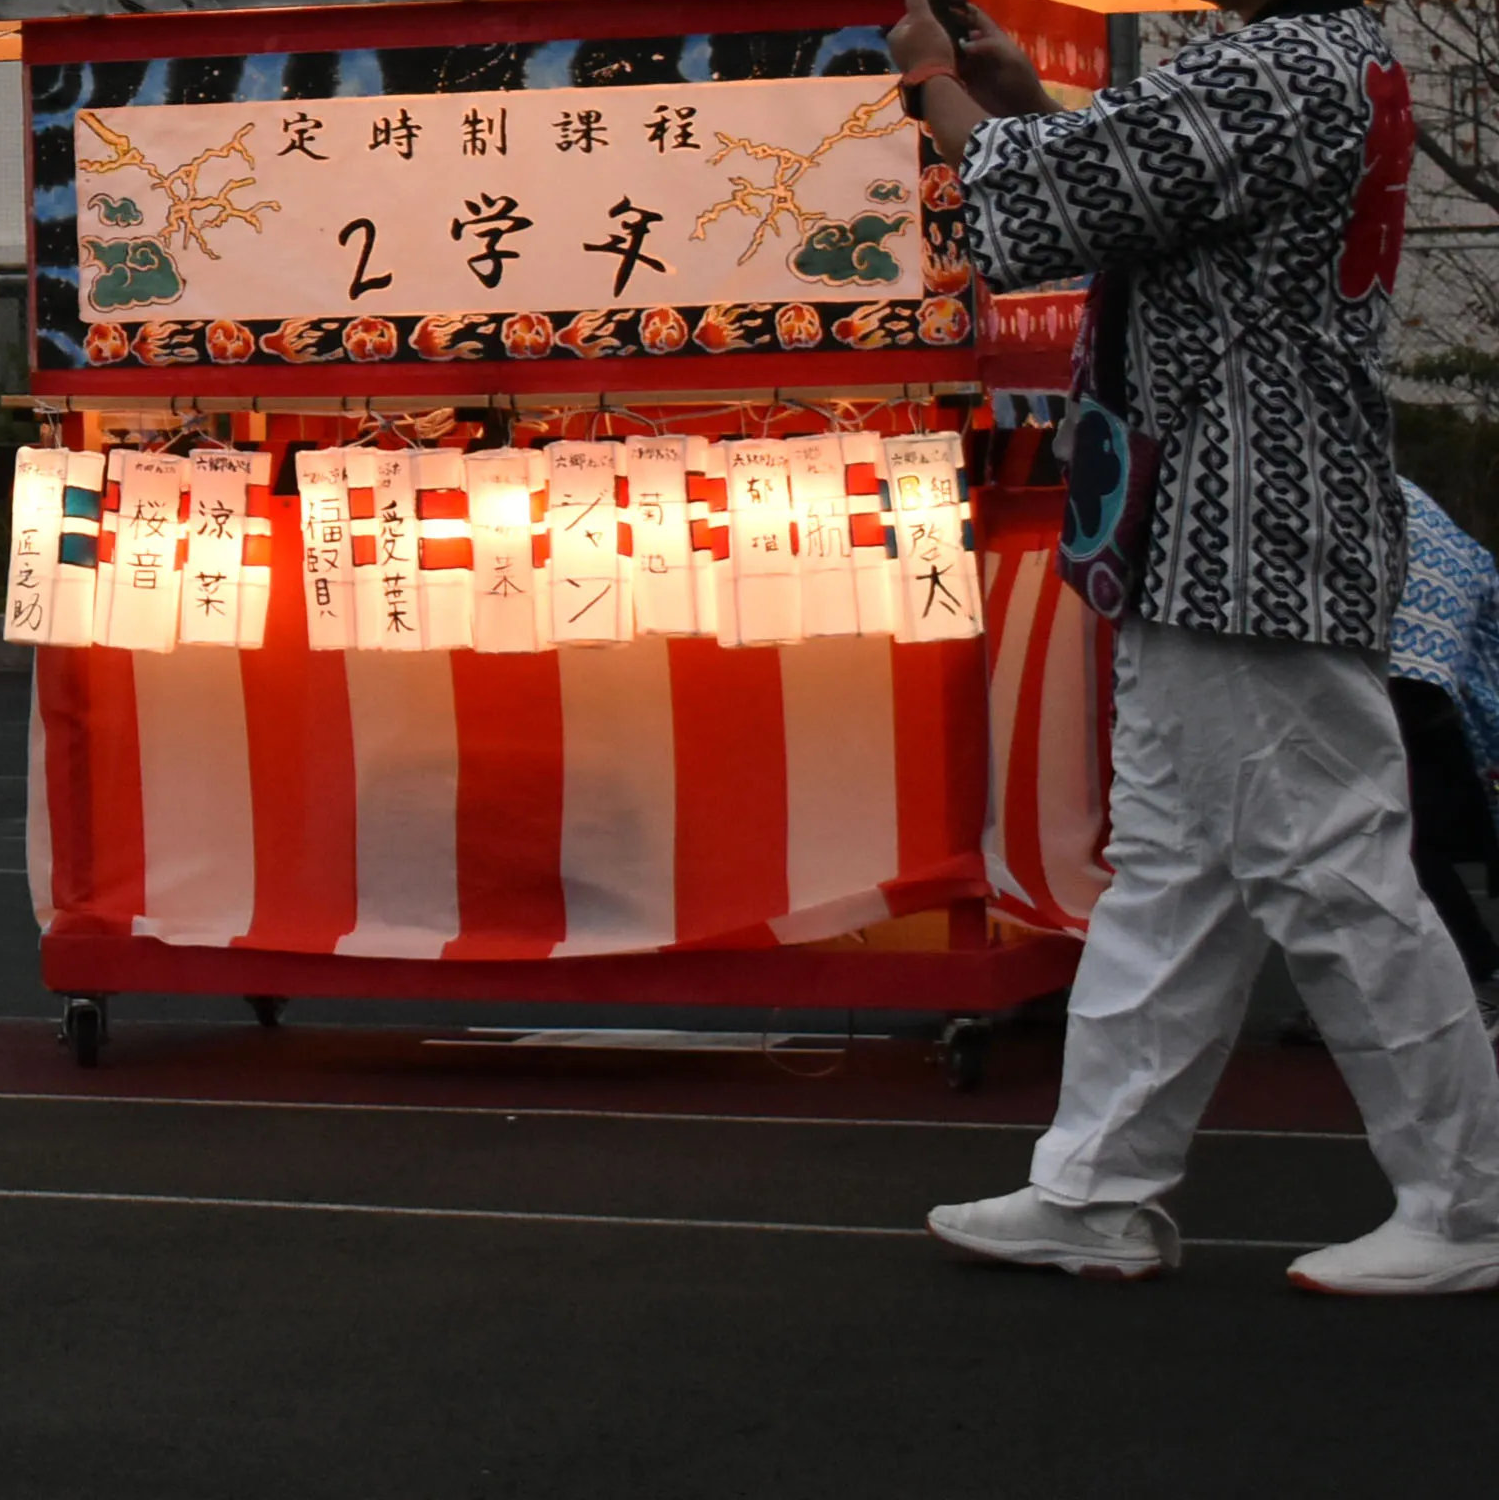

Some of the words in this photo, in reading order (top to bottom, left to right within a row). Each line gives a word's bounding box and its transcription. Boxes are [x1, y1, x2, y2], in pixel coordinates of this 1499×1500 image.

[276, 103, 701, 159] 定時制課程
[126, 498, 168, 589] 桜音
[193, 500, 235, 617] 涼菜
